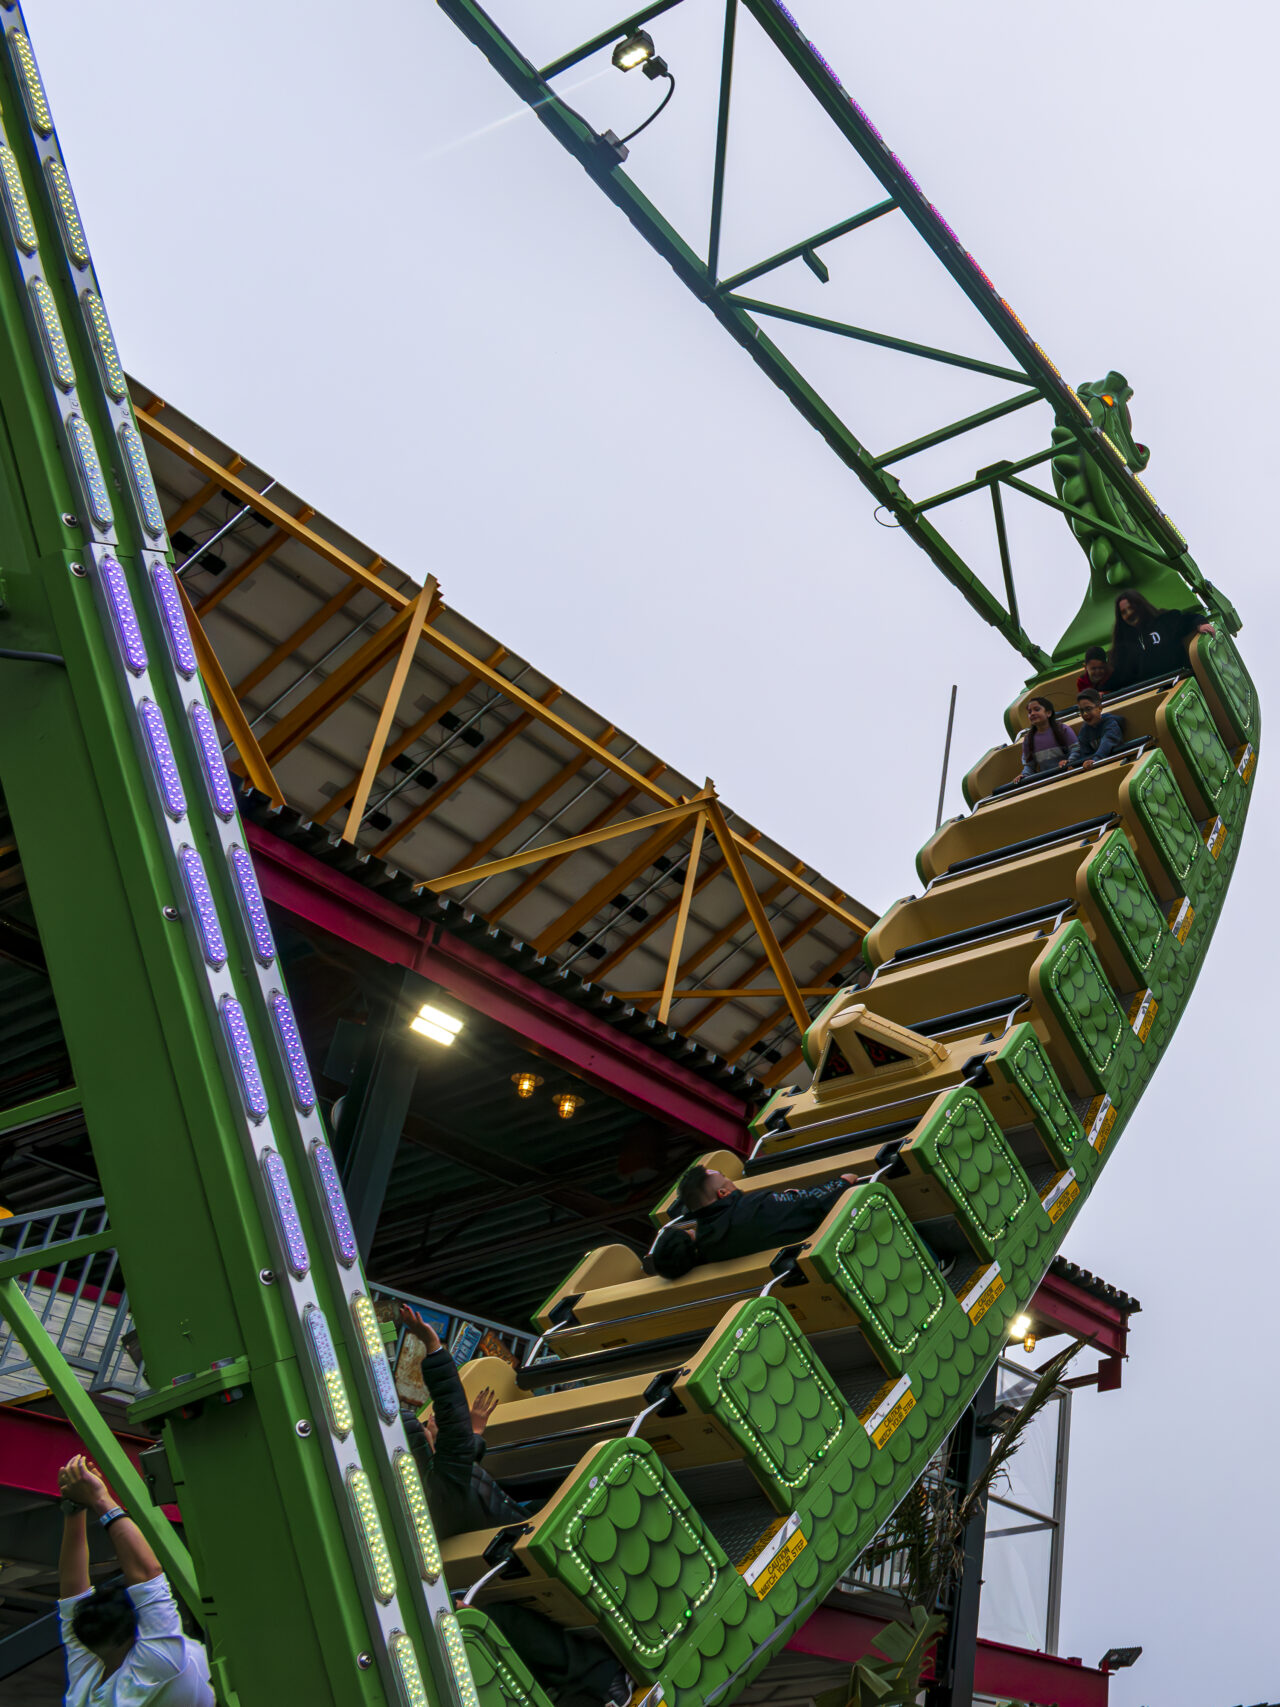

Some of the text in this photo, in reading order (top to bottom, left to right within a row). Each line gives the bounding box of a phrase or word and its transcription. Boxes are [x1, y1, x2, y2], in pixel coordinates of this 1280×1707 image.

[1149, 632, 1160, 645] D
[878, 1398, 914, 1446] WATCH YOUR STEP
[883, 1402, 903, 1428] CAUTION
[758, 1573, 778, 1596] WATCH
[776, 1555, 792, 1574] YOUR
[790, 1539, 804, 1557] STEP
[767, 1546, 790, 1575] CAUTION
